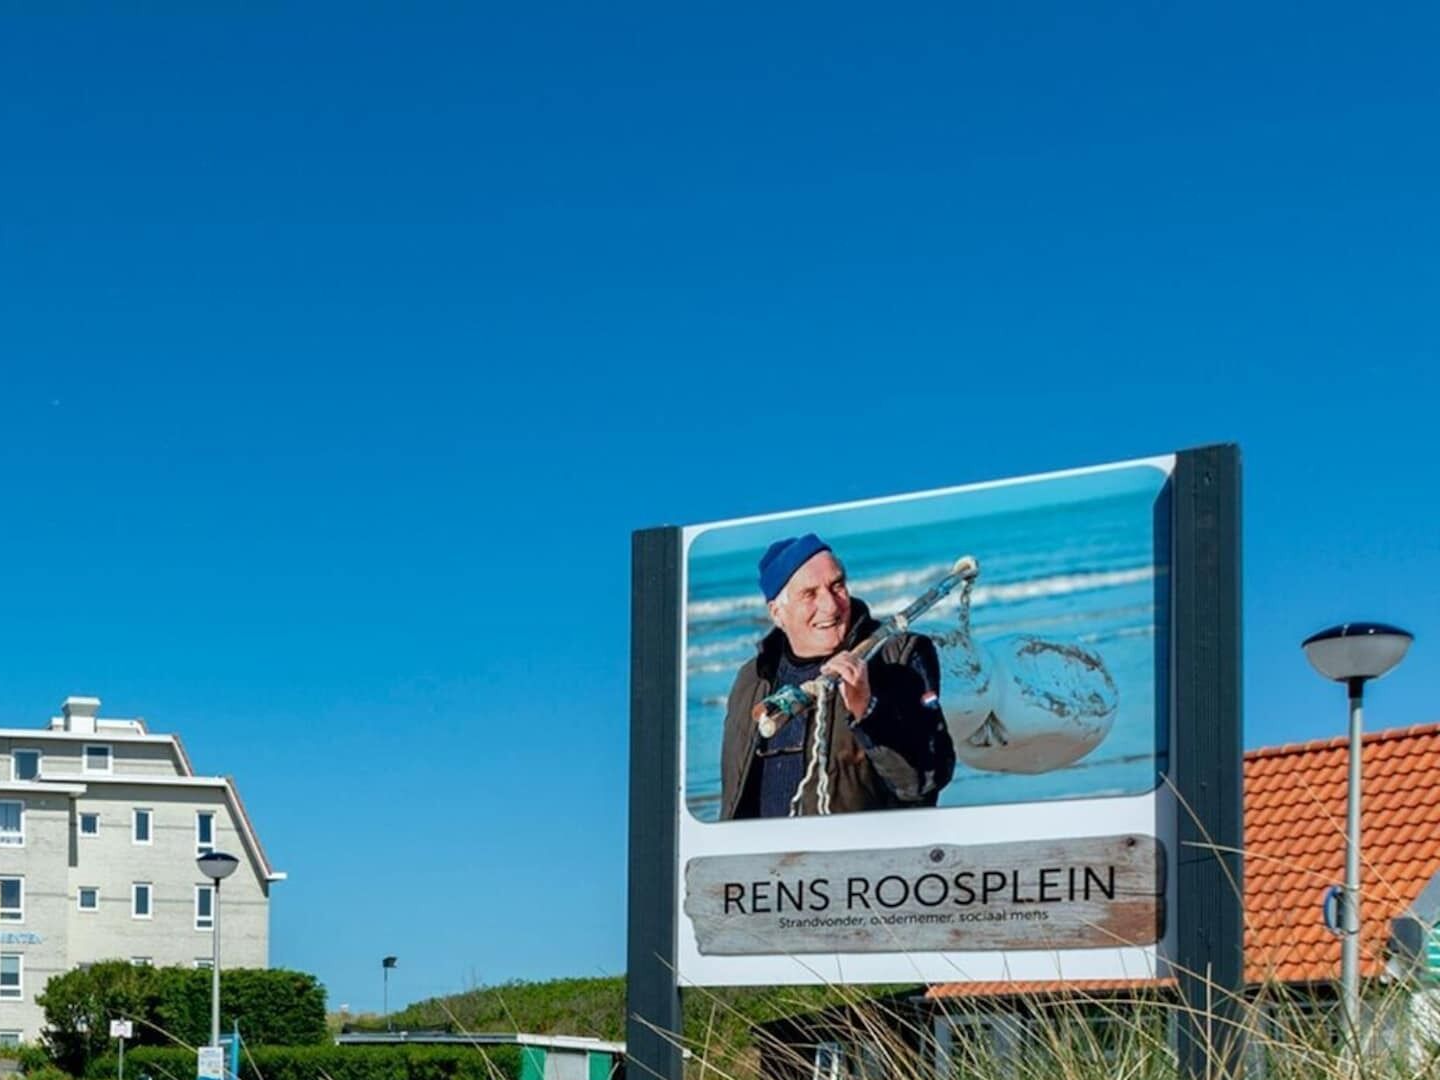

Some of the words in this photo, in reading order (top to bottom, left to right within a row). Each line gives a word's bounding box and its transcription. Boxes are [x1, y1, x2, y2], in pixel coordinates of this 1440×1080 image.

[724, 878, 830, 915] RENS
[847, 866, 1115, 910] ROOSPLEIN
[778, 915, 867, 930] Strandvonder,
[870, 910, 955, 926] ondernemer,
[959, 909, 1007, 924] sociaal
[1010, 911, 1049, 922] mens
